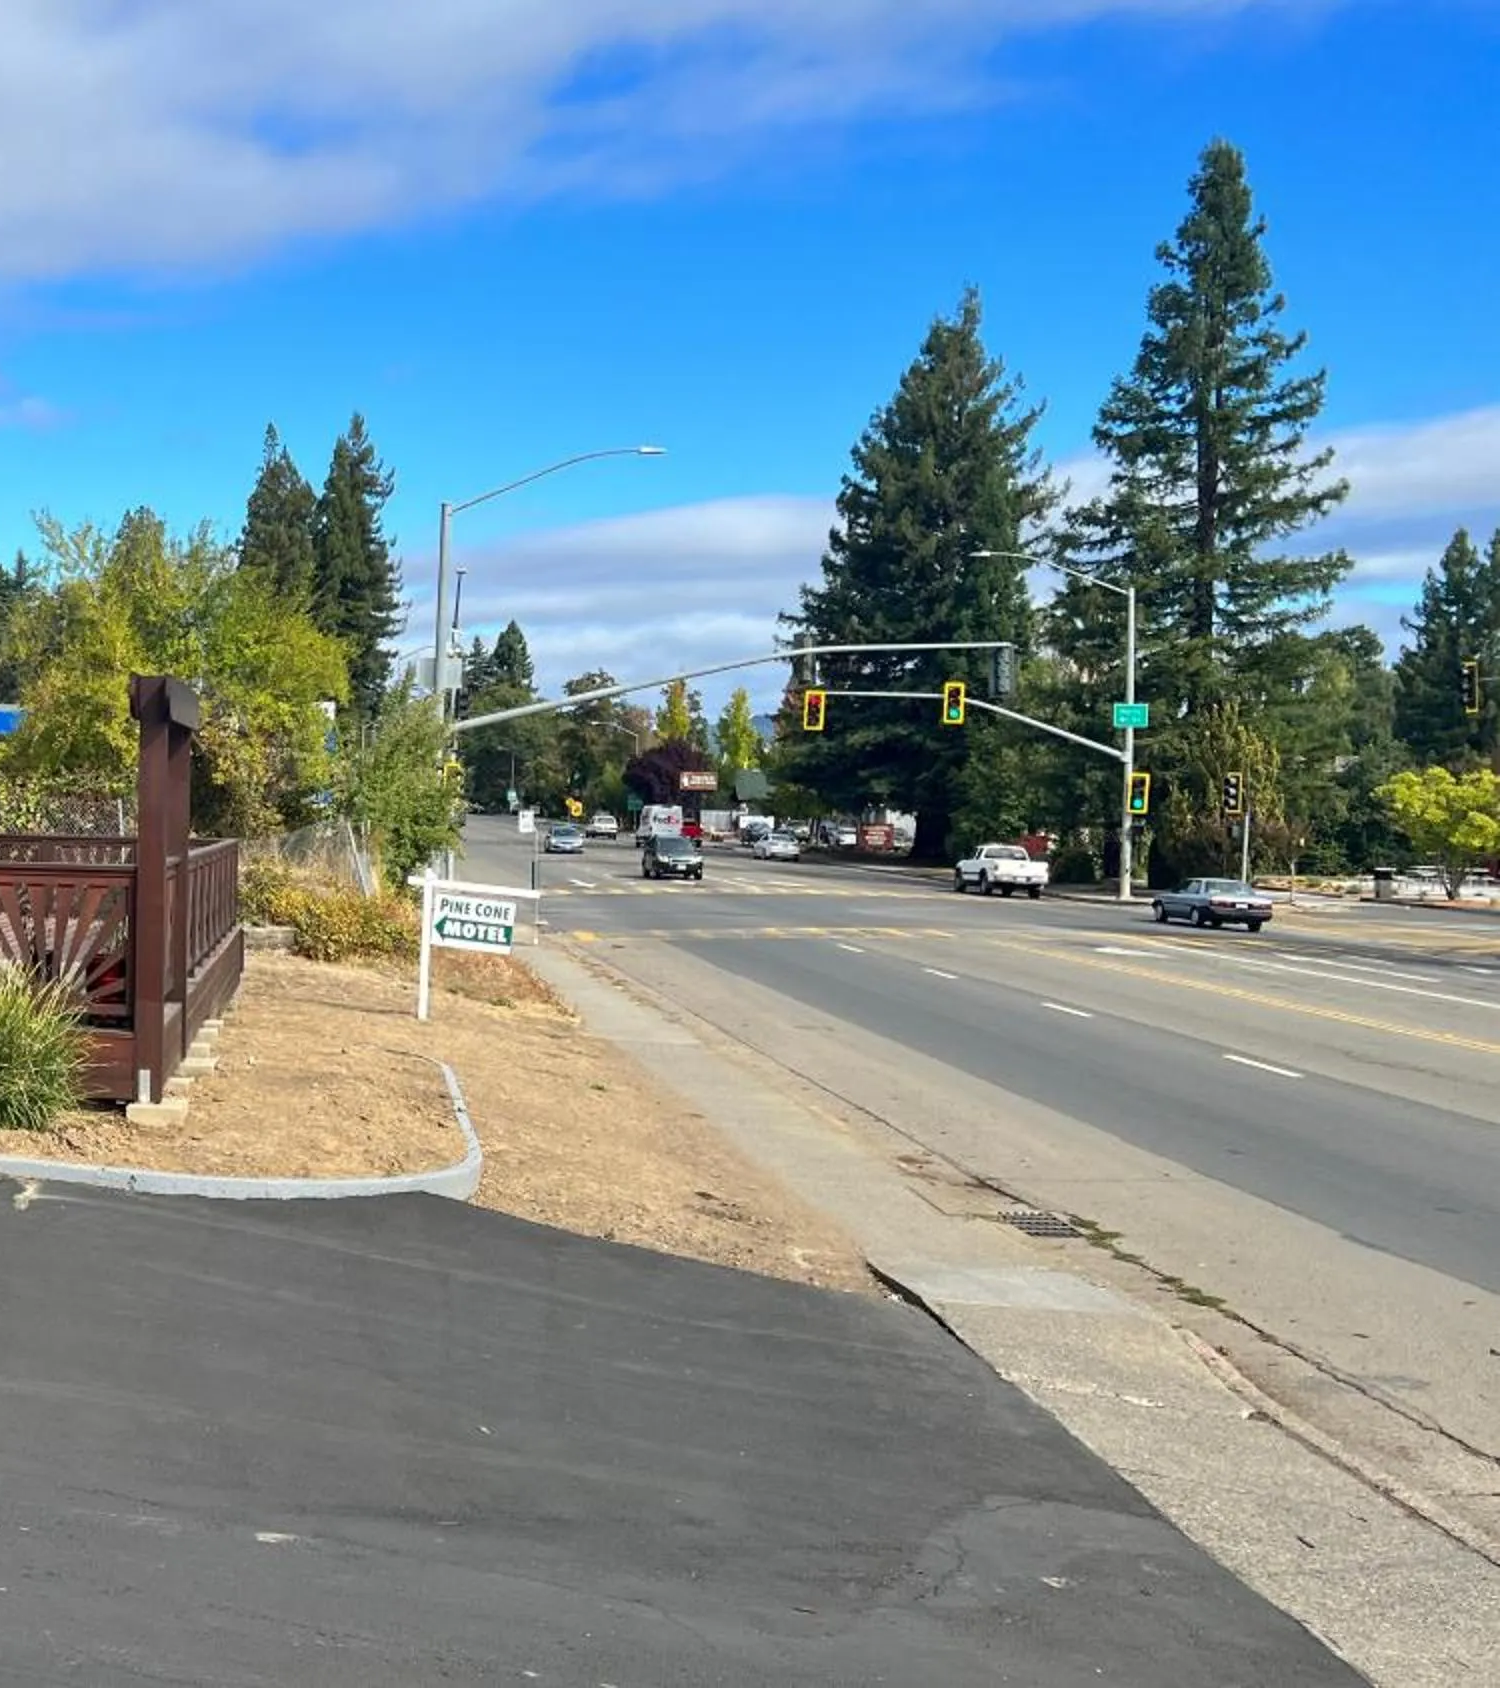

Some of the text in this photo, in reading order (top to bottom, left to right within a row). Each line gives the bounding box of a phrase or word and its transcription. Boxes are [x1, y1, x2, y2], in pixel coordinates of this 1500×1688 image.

[440, 897, 510, 921] PINE CONE
[443, 920, 507, 944] MOTEL
